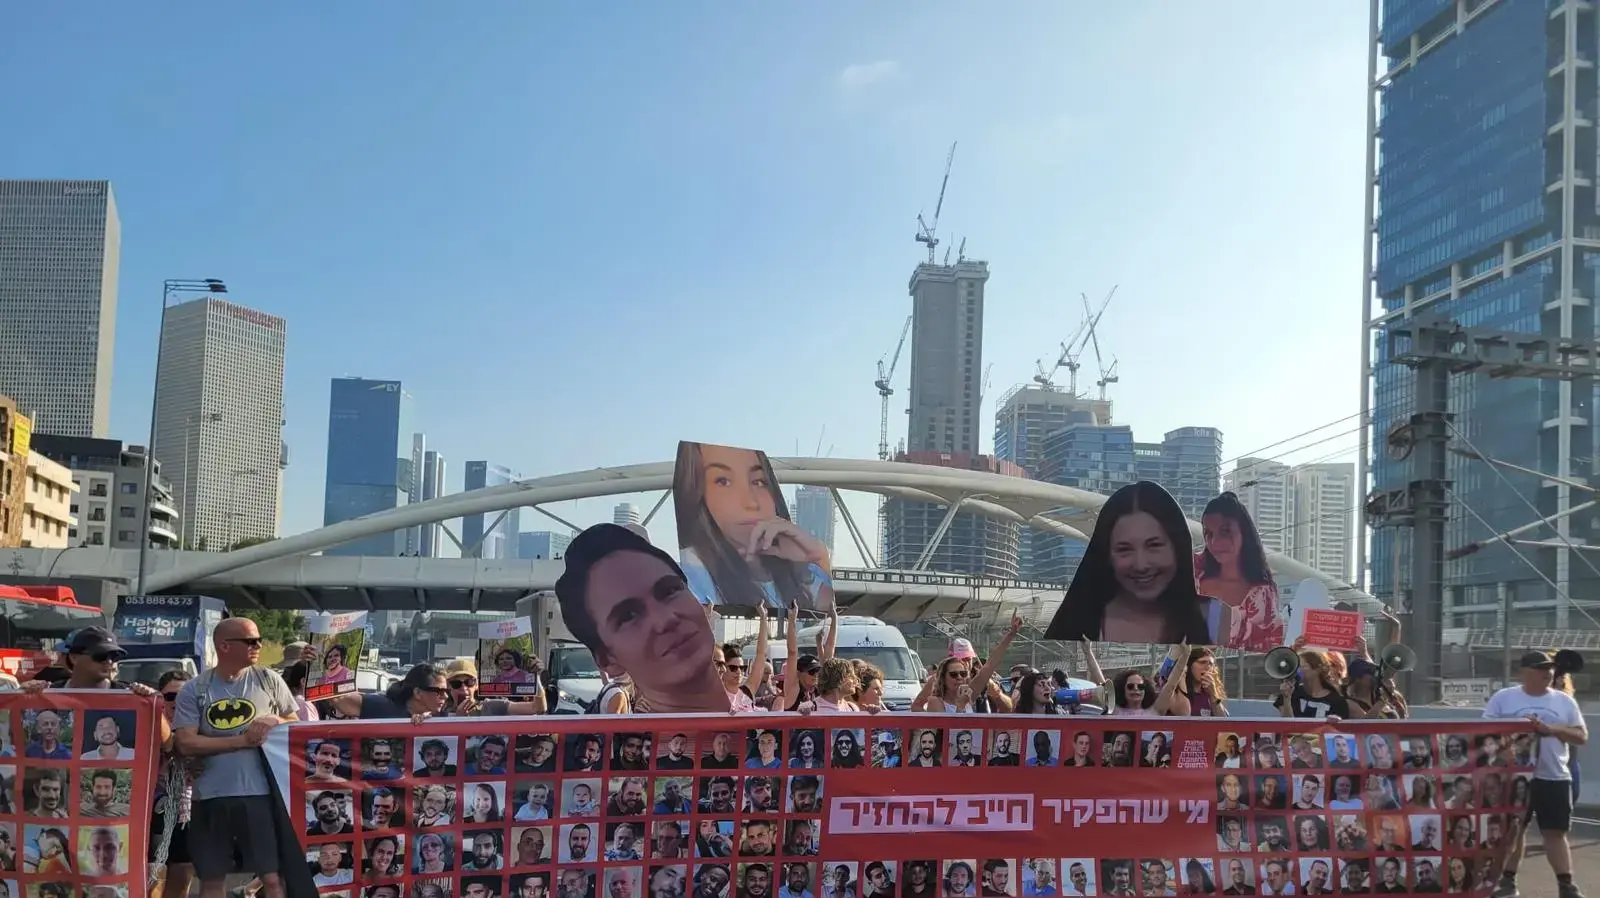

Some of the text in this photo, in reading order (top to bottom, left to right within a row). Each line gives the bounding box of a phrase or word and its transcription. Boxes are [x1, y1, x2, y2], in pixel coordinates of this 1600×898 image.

[386, 383, 399, 392] EY
[123, 617, 189, 628] HaMovil
[840, 798, 1210, 828] מי שהפקיר חייב להחזיר
